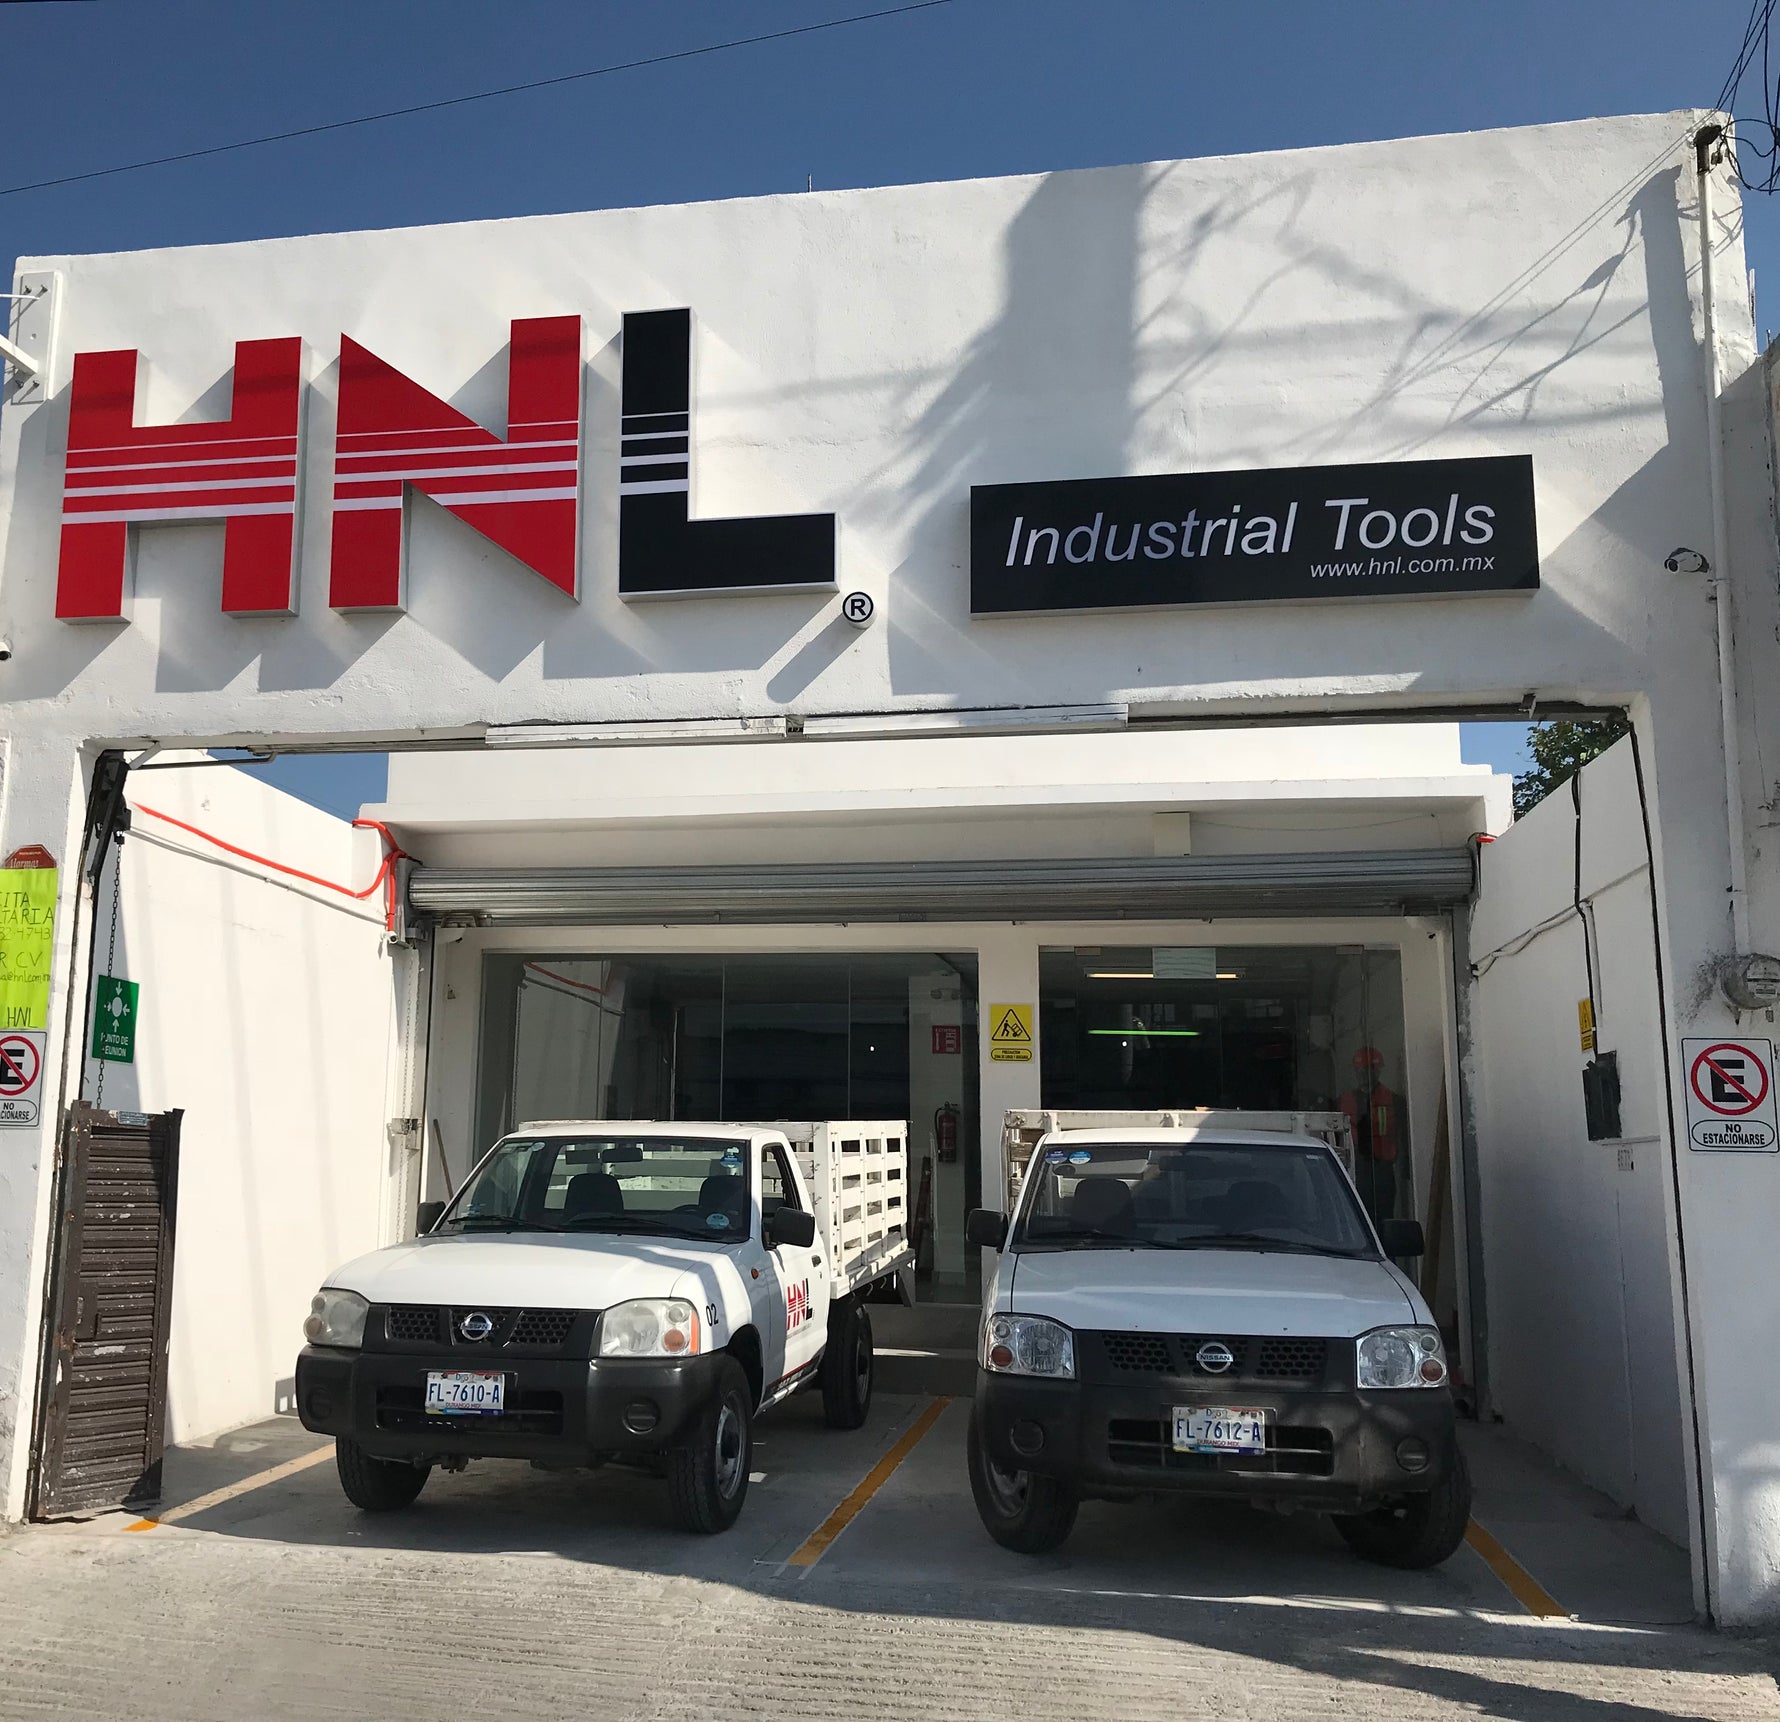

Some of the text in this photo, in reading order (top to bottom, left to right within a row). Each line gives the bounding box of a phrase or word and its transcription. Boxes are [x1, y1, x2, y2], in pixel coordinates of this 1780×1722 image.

[55, 306, 838, 620] HNL
[1005, 493, 1496, 567] Industrial Tools
[1310, 553, 1495, 579] www.hnl.com.mx
[0, 891, 31, 908] ITA
[0, 906, 54, 925] TARIA
[15, 951, 43, 968] CV
[7, 1006, 39, 1028] HNL
[102, 1045, 127, 1057] EUNION
[3, 1102, 15, 1110] NO
[1725, 1123, 1742, 1133] NO
[1702, 1132, 1766, 1145] ESTACIONARSE
[787, 1277, 814, 1331] HNL
[705, 1302, 719, 1327] 02
[1200, 1353, 1231, 1361] NISSAN
[428, 1383, 500, 1403] FL-7610-A
[1176, 1418, 1261, 1442] FL-7612-A
